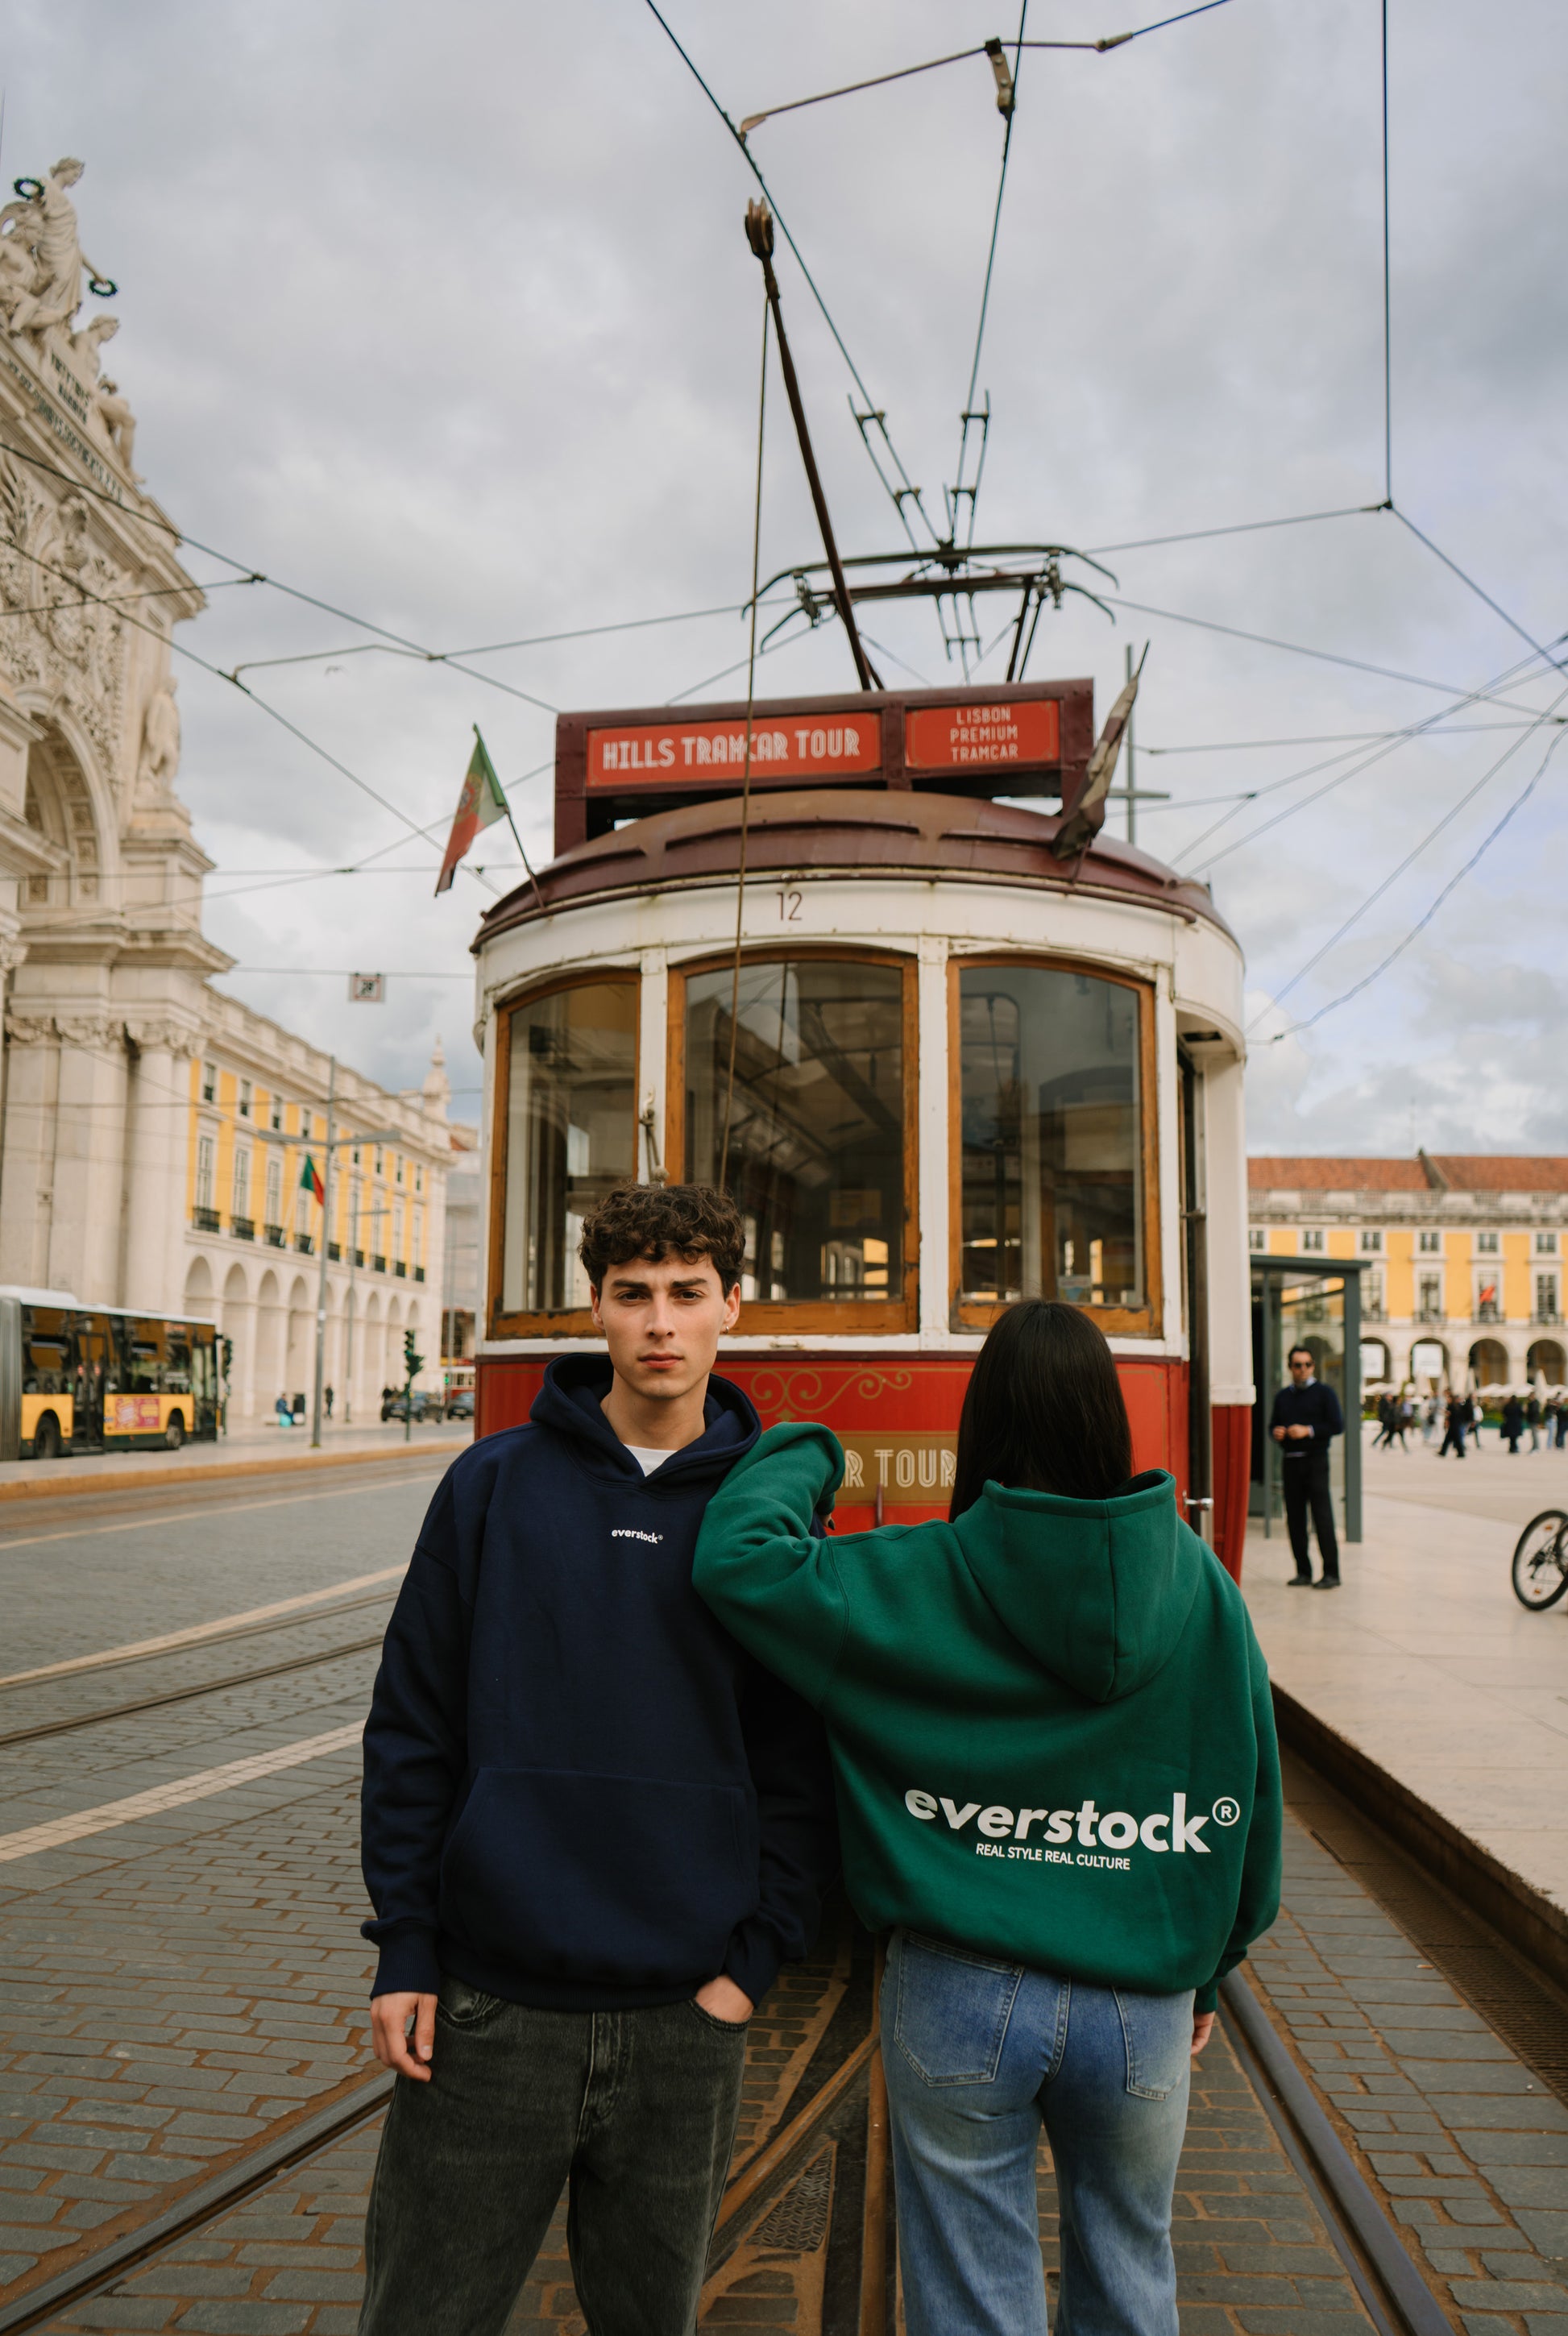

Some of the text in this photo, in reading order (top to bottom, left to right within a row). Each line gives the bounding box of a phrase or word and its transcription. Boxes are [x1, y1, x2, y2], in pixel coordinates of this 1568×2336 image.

[956, 706, 1011, 725] LISBON
[949, 724, 1018, 744] PREMIUM
[602, 727, 861, 770] HILLS TRAMCAR TOUR
[951, 743, 1018, 762] TRAMCAR
[776, 891, 803, 921] 12
[874, 1449, 957, 1488] TOUR
[976, 1843, 1130, 1871] REAL STYLE REAL CULTURE
